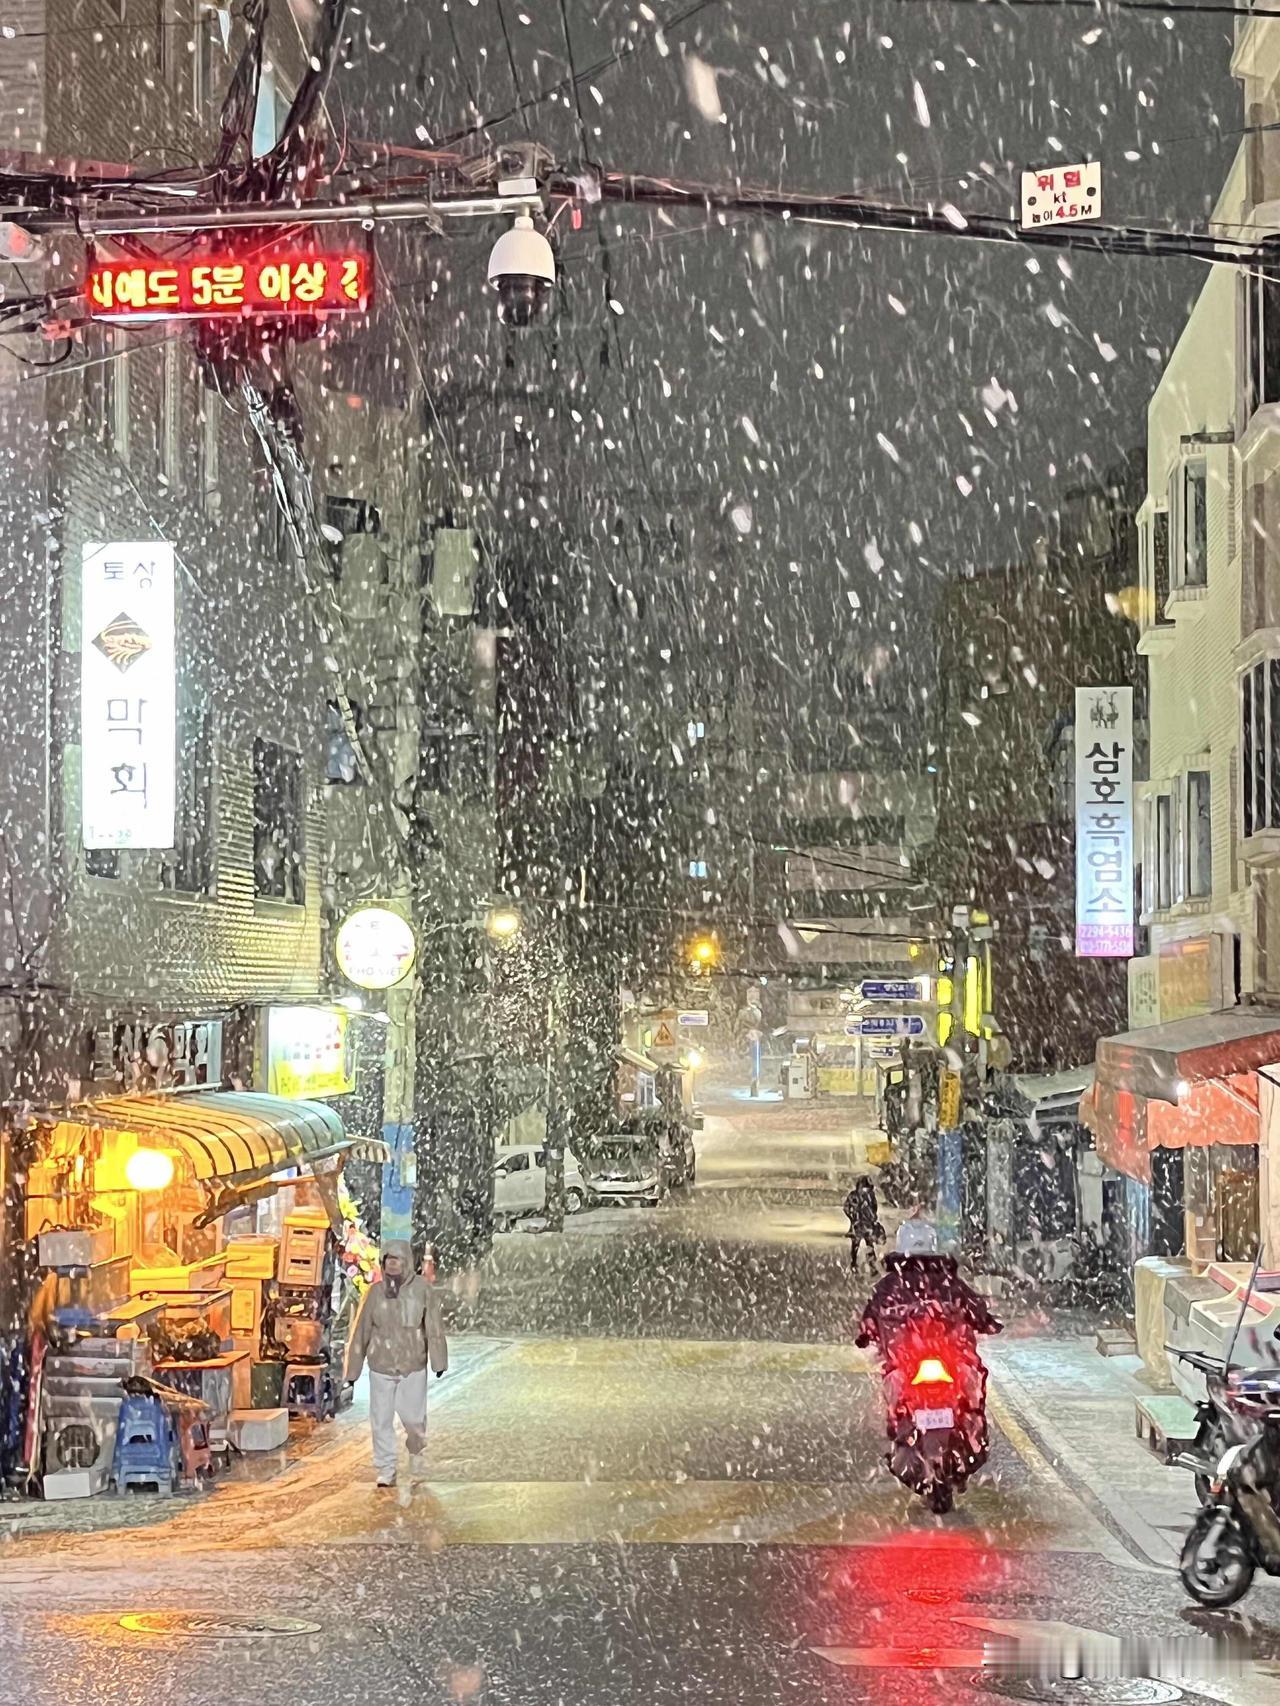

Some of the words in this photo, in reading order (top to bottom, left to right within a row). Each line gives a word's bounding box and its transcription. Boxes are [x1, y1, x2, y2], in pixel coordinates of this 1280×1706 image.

[1037, 170, 1081, 191] 위험
[1053, 191, 1067, 204] kt
[192, 265, 243, 304] 5분
[259, 261, 327, 301] 이상
